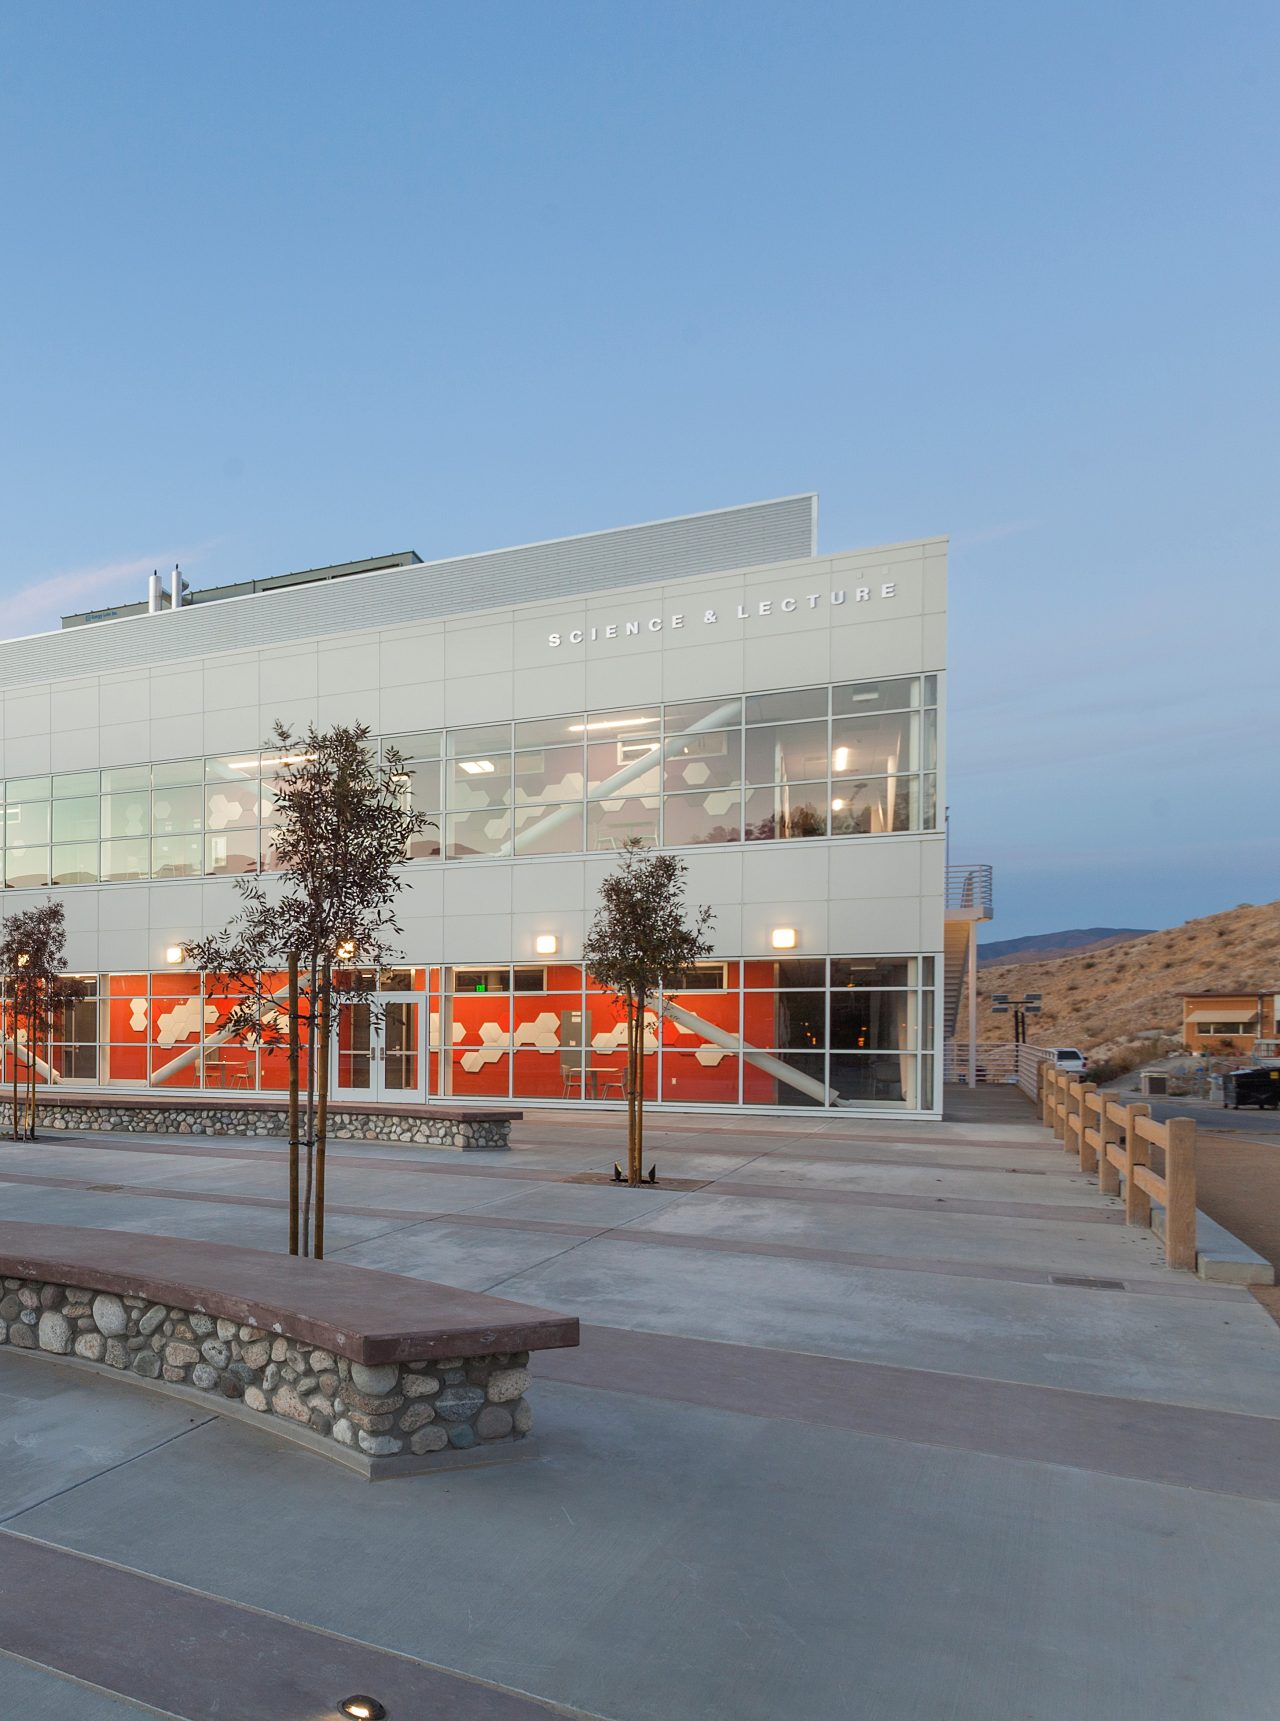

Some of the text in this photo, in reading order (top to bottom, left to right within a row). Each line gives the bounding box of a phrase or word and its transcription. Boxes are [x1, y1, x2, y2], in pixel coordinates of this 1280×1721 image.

[547, 583, 896, 648] SCIENCE & LECTURE
